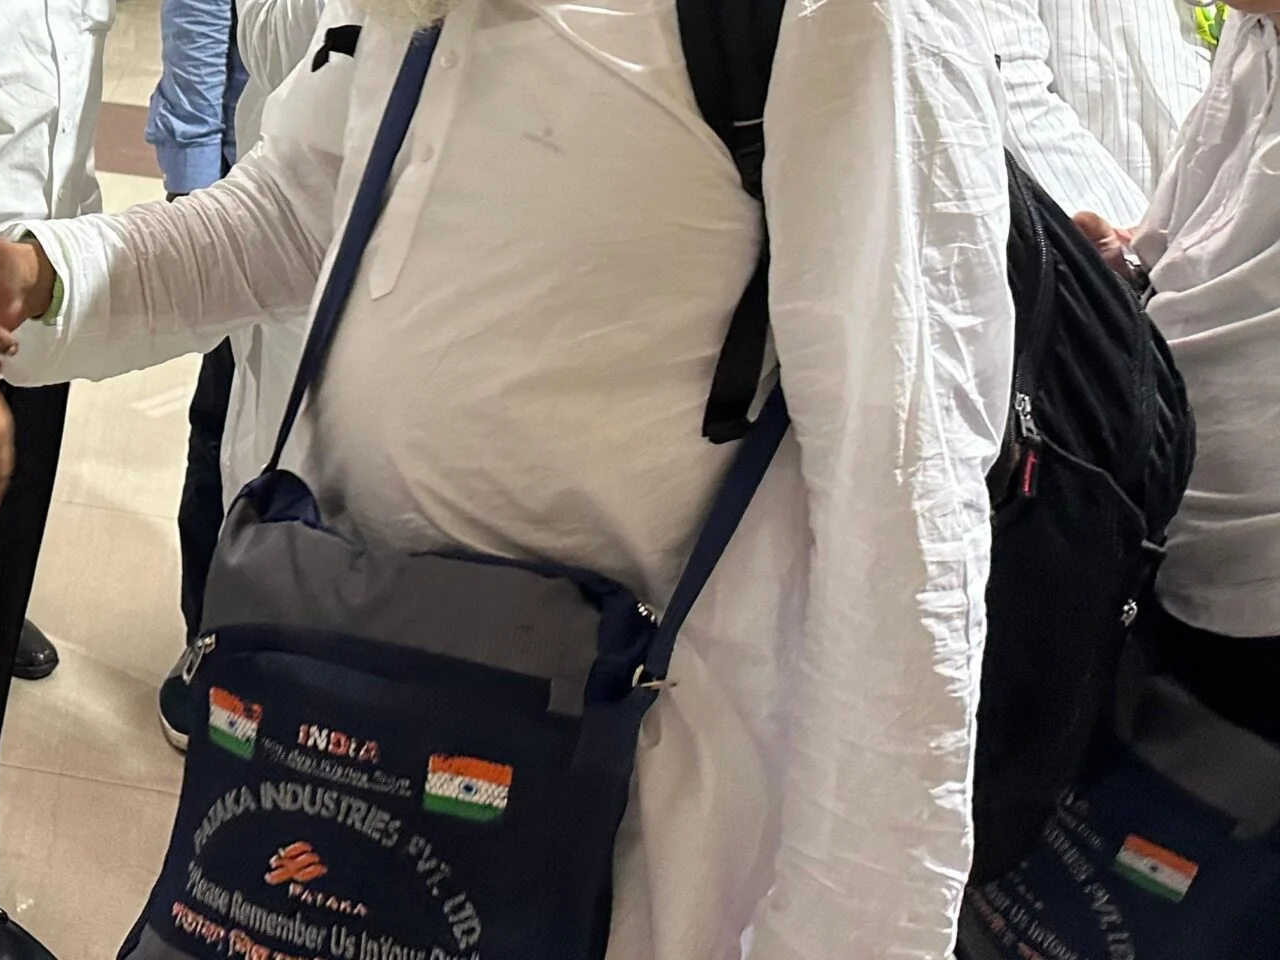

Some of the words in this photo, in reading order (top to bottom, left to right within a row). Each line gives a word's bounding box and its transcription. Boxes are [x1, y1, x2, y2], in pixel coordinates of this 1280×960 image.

[298, 723, 380, 764] INDIA
[259, 781, 402, 847] INDUSTRIES
[229, 890, 328, 952] Remember
[330, 923, 356, 958] Us
